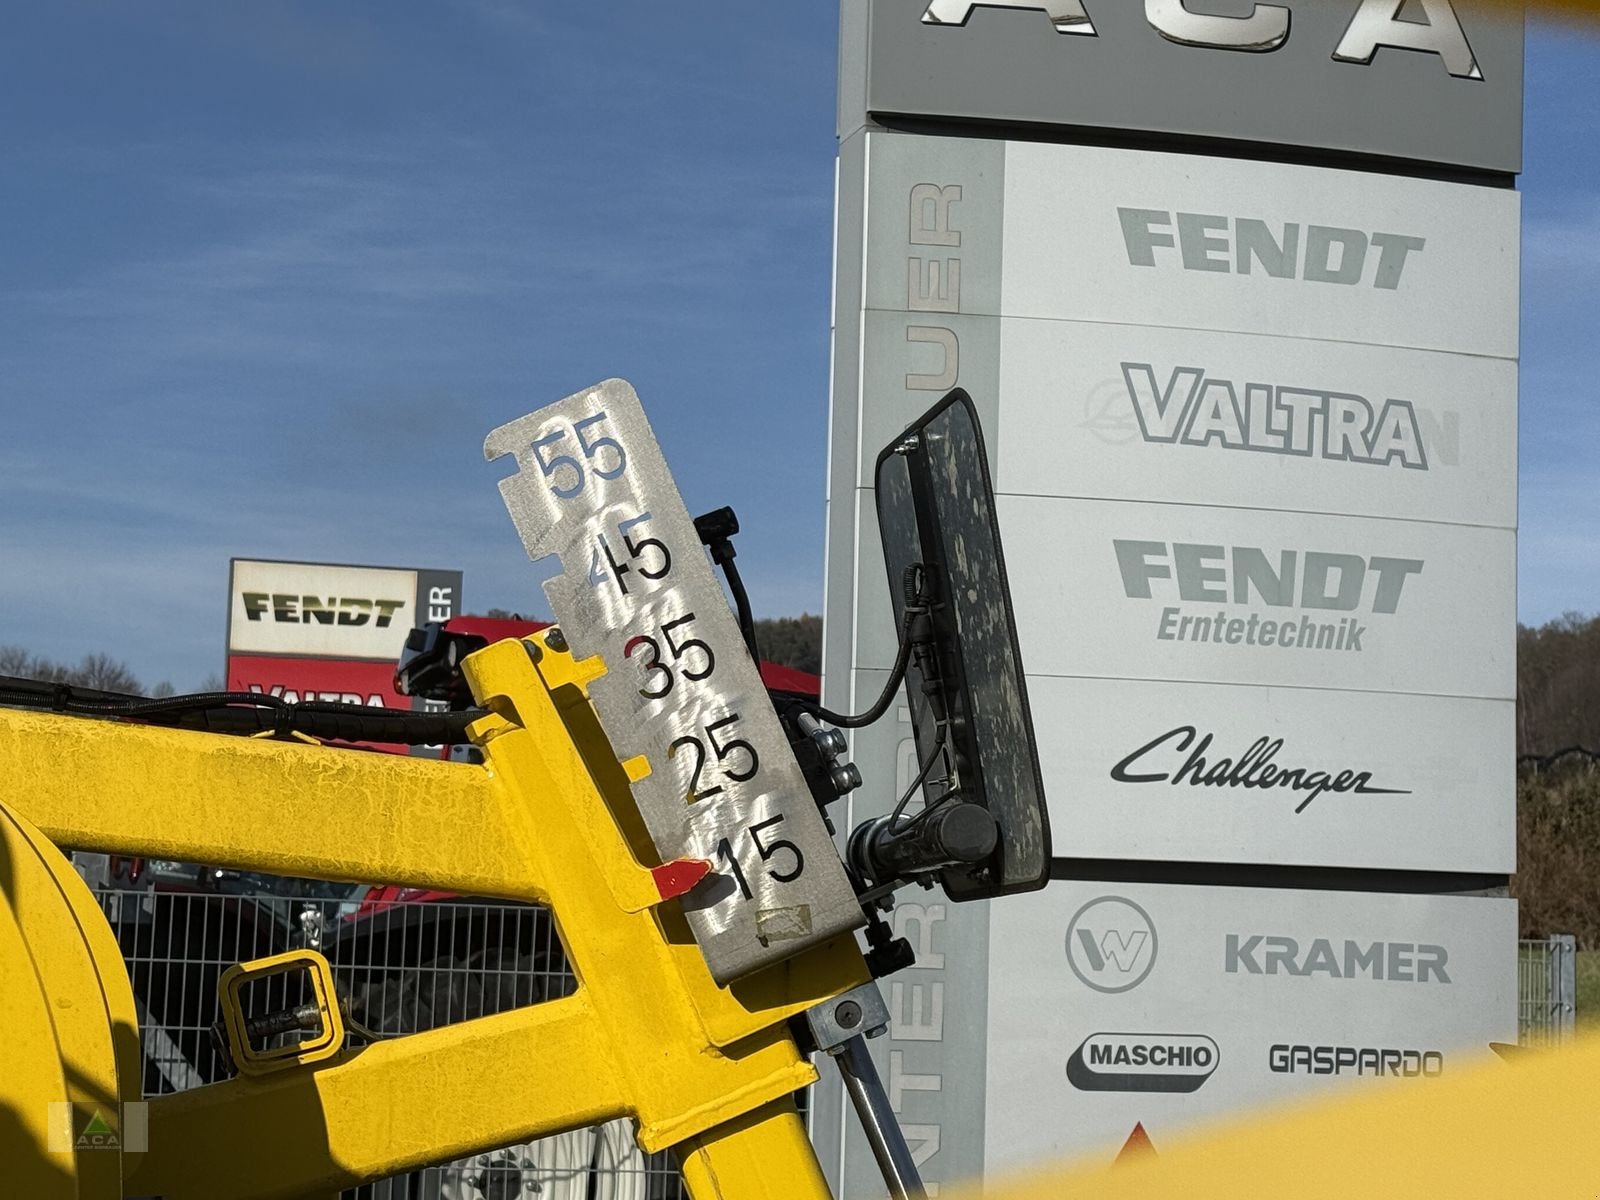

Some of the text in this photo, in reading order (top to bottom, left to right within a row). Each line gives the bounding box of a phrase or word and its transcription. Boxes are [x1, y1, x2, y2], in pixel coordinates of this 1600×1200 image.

[1117, 208, 1425, 290] FENDT
[532, 412, 627, 499] 55
[1121, 362, 1429, 471] VALTRA
[589, 512, 672, 595] 45
[1113, 539, 1425, 614] FENDT
[243, 592, 405, 627] FENDT
[1157, 607, 1366, 652] Erntetechnik
[624, 613, 715, 700] 35
[668, 713, 760, 804] 25
[1110, 725, 1413, 814] Challenger
[716, 814, 805, 900] 15
[1225, 934, 1453, 984] KRAMER
[1089, 1044, 1213, 1068] MASCHIO
[1269, 1044, 1444, 1078] GASPARDO
